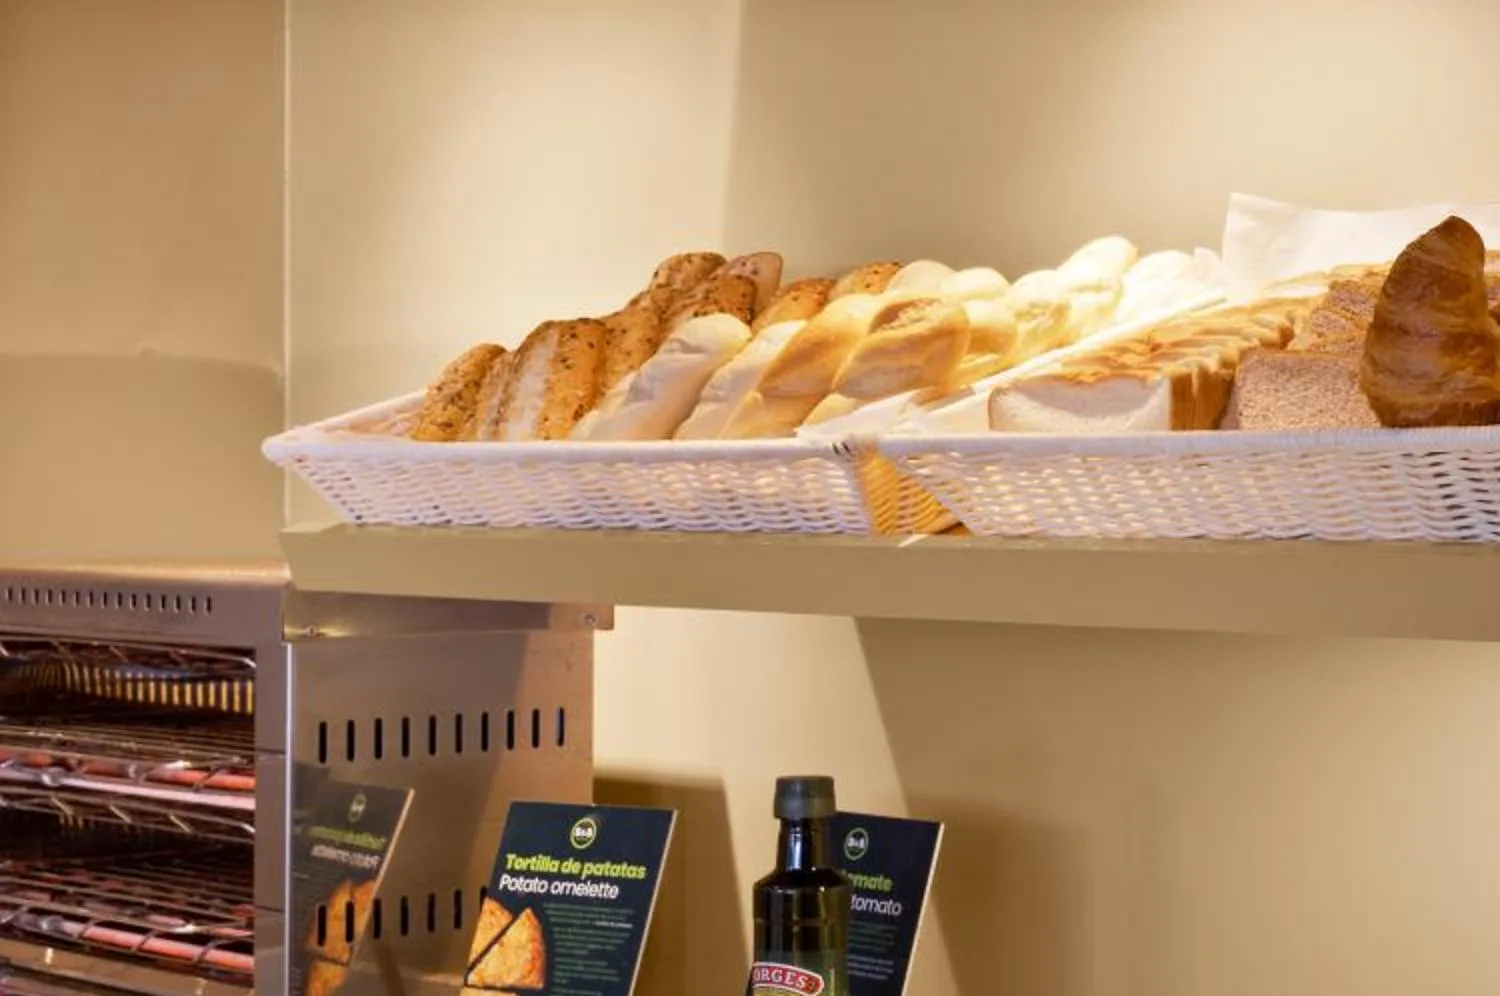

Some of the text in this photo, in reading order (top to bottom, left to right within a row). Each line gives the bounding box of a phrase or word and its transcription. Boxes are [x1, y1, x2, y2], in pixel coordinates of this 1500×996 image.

[506, 853, 647, 881] Tortilla de patatas
[499, 873, 619, 900] Potato omelette
[851, 893, 902, 916] tomato
[753, 967, 807, 989] ORGES
